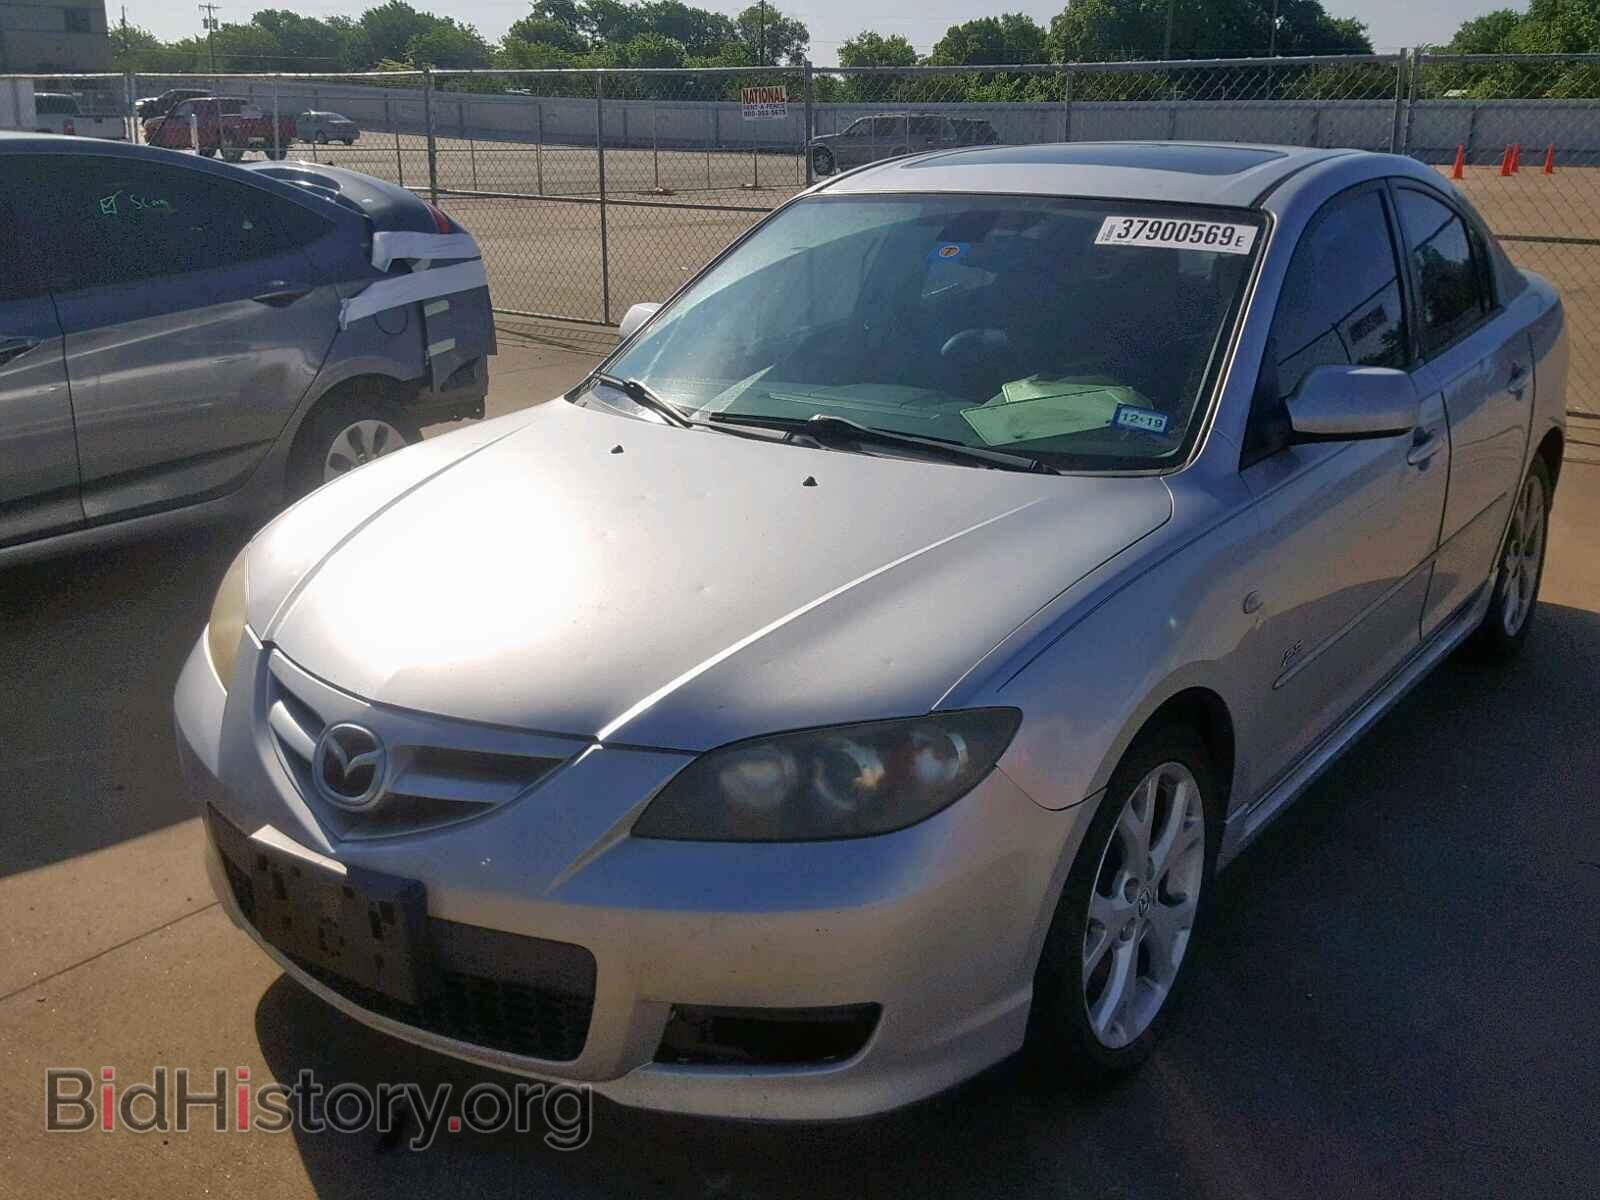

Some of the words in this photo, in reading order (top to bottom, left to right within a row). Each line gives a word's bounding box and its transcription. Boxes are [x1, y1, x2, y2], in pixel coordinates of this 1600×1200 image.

[743, 87, 785, 104] NATIONAL
[1117, 218, 1236, 247] 37900569
[1235, 235, 1246, 247] E
